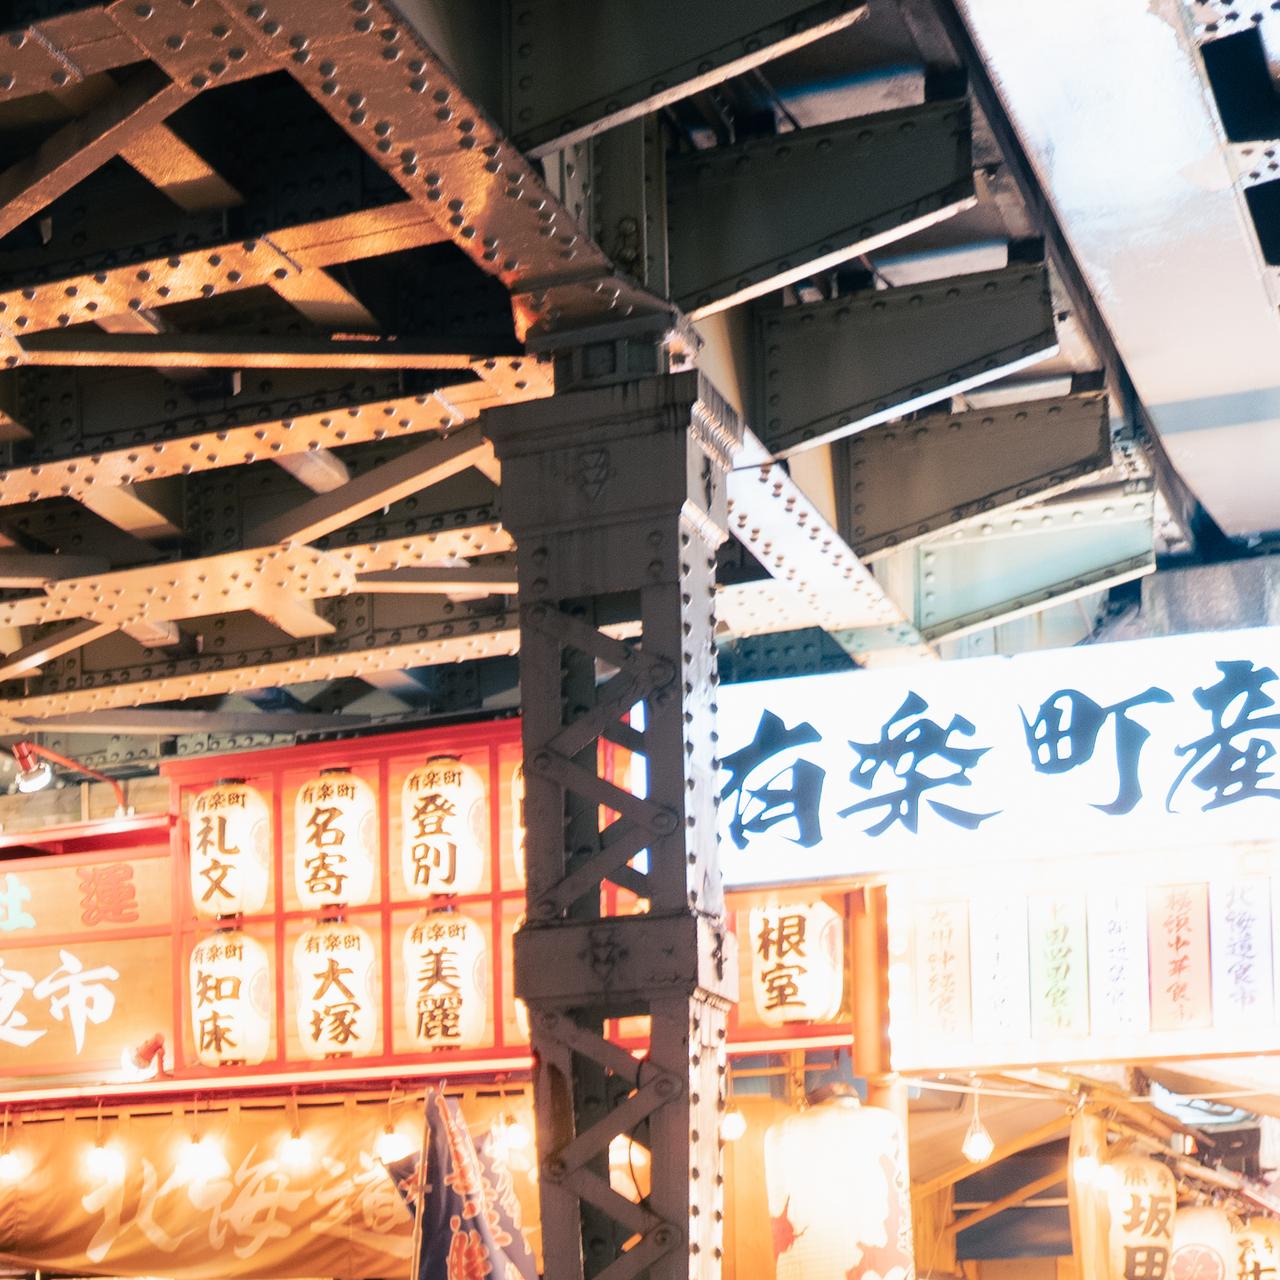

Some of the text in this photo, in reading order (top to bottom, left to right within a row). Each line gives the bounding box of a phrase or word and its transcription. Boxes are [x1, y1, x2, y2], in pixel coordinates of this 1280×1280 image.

[195, 815, 240, 902] 礼文
[304, 806, 349, 896] 名寄
[410, 793, 457, 888] 登別
[311, 958, 361, 1046] 大塚
[757, 913, 807, 1010] 根室
[195, 968, 242, 1055] 知床
